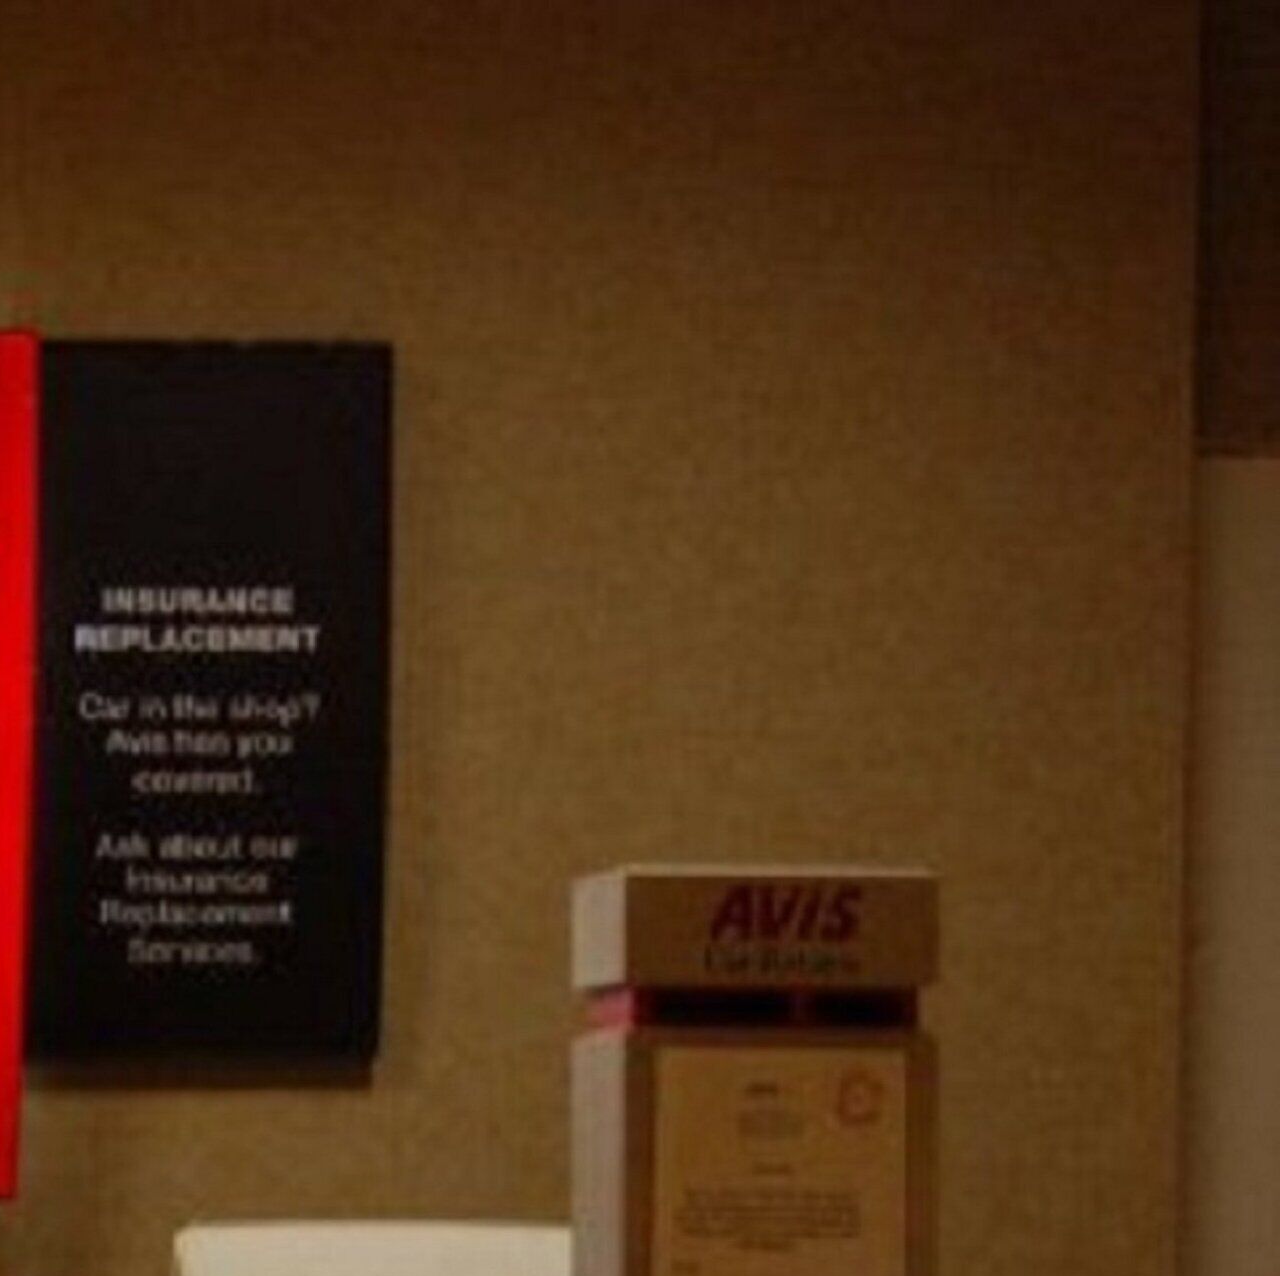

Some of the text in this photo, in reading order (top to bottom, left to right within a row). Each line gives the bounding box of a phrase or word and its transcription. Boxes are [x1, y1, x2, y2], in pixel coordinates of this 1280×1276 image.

[101, 587, 295, 615] INSURANCE
[74, 623, 321, 652] REPLACEMENT
[79, 693, 130, 721] Car
[237, 735, 293, 759] you
[711, 884, 862, 942] AVIS
